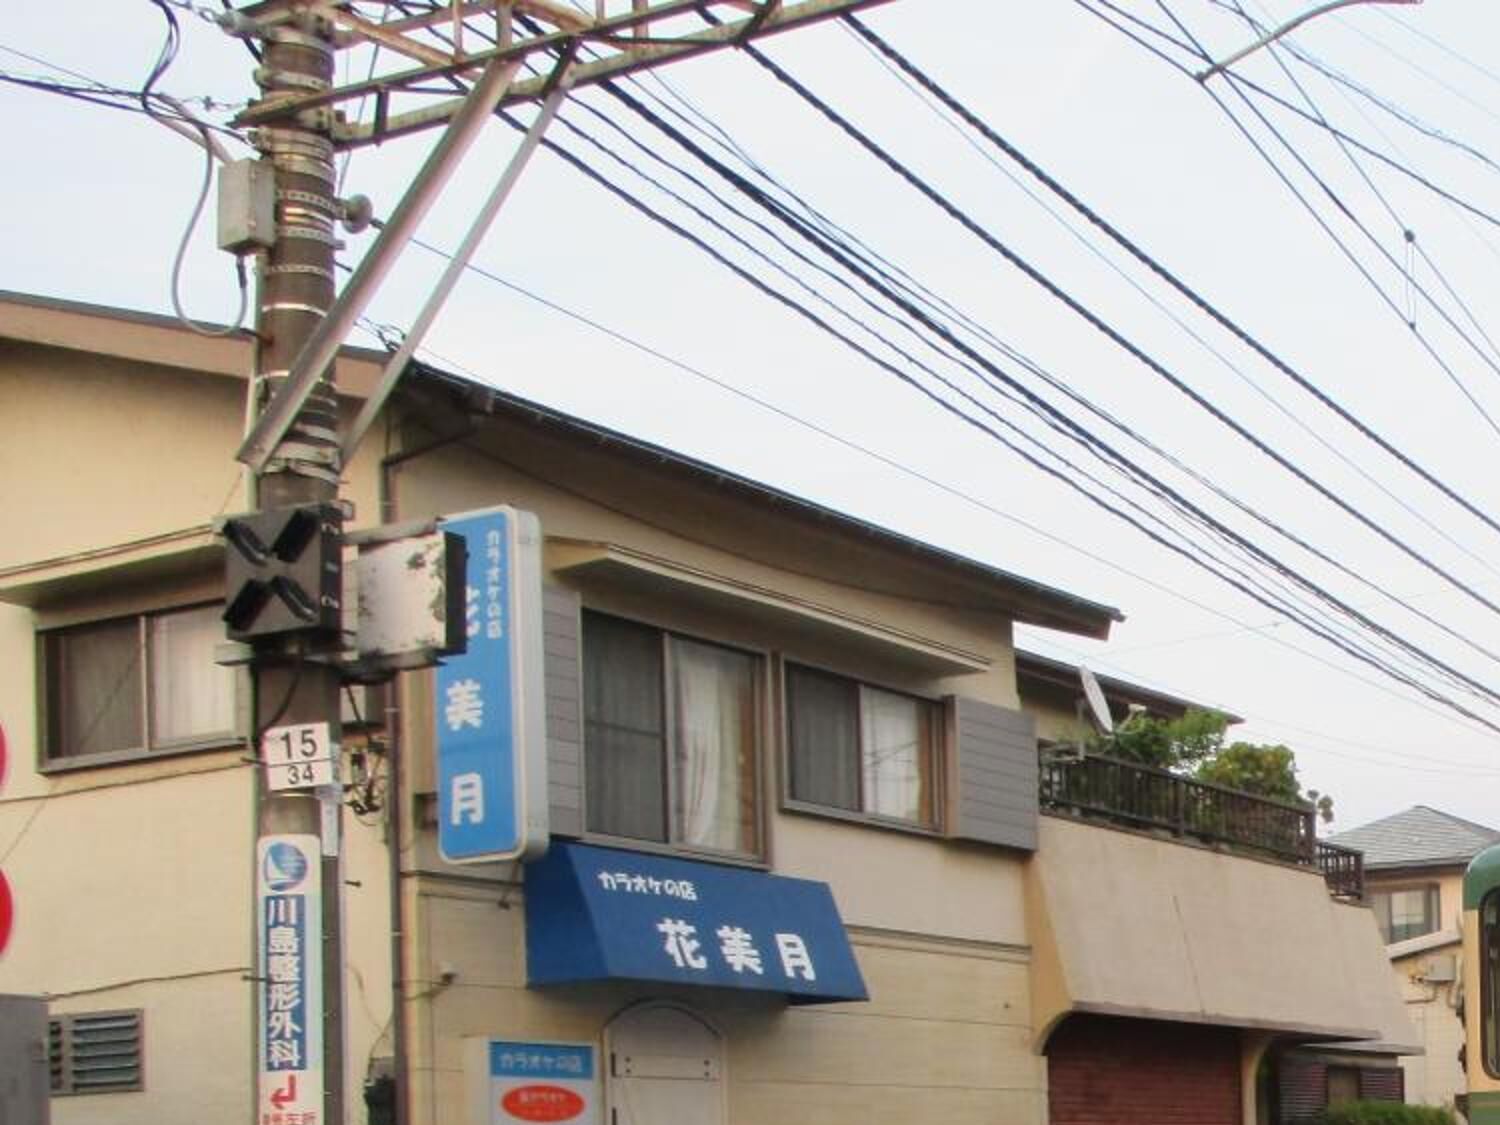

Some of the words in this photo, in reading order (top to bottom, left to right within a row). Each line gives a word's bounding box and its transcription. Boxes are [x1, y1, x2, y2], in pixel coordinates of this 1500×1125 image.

[279, 728, 318, 761] 15
[286, 764, 315, 785] 34
[597, 869, 698, 902] カラオケの店
[657, 917, 818, 982] 花美月
[268, 897, 303, 1069] 川島整形外科
